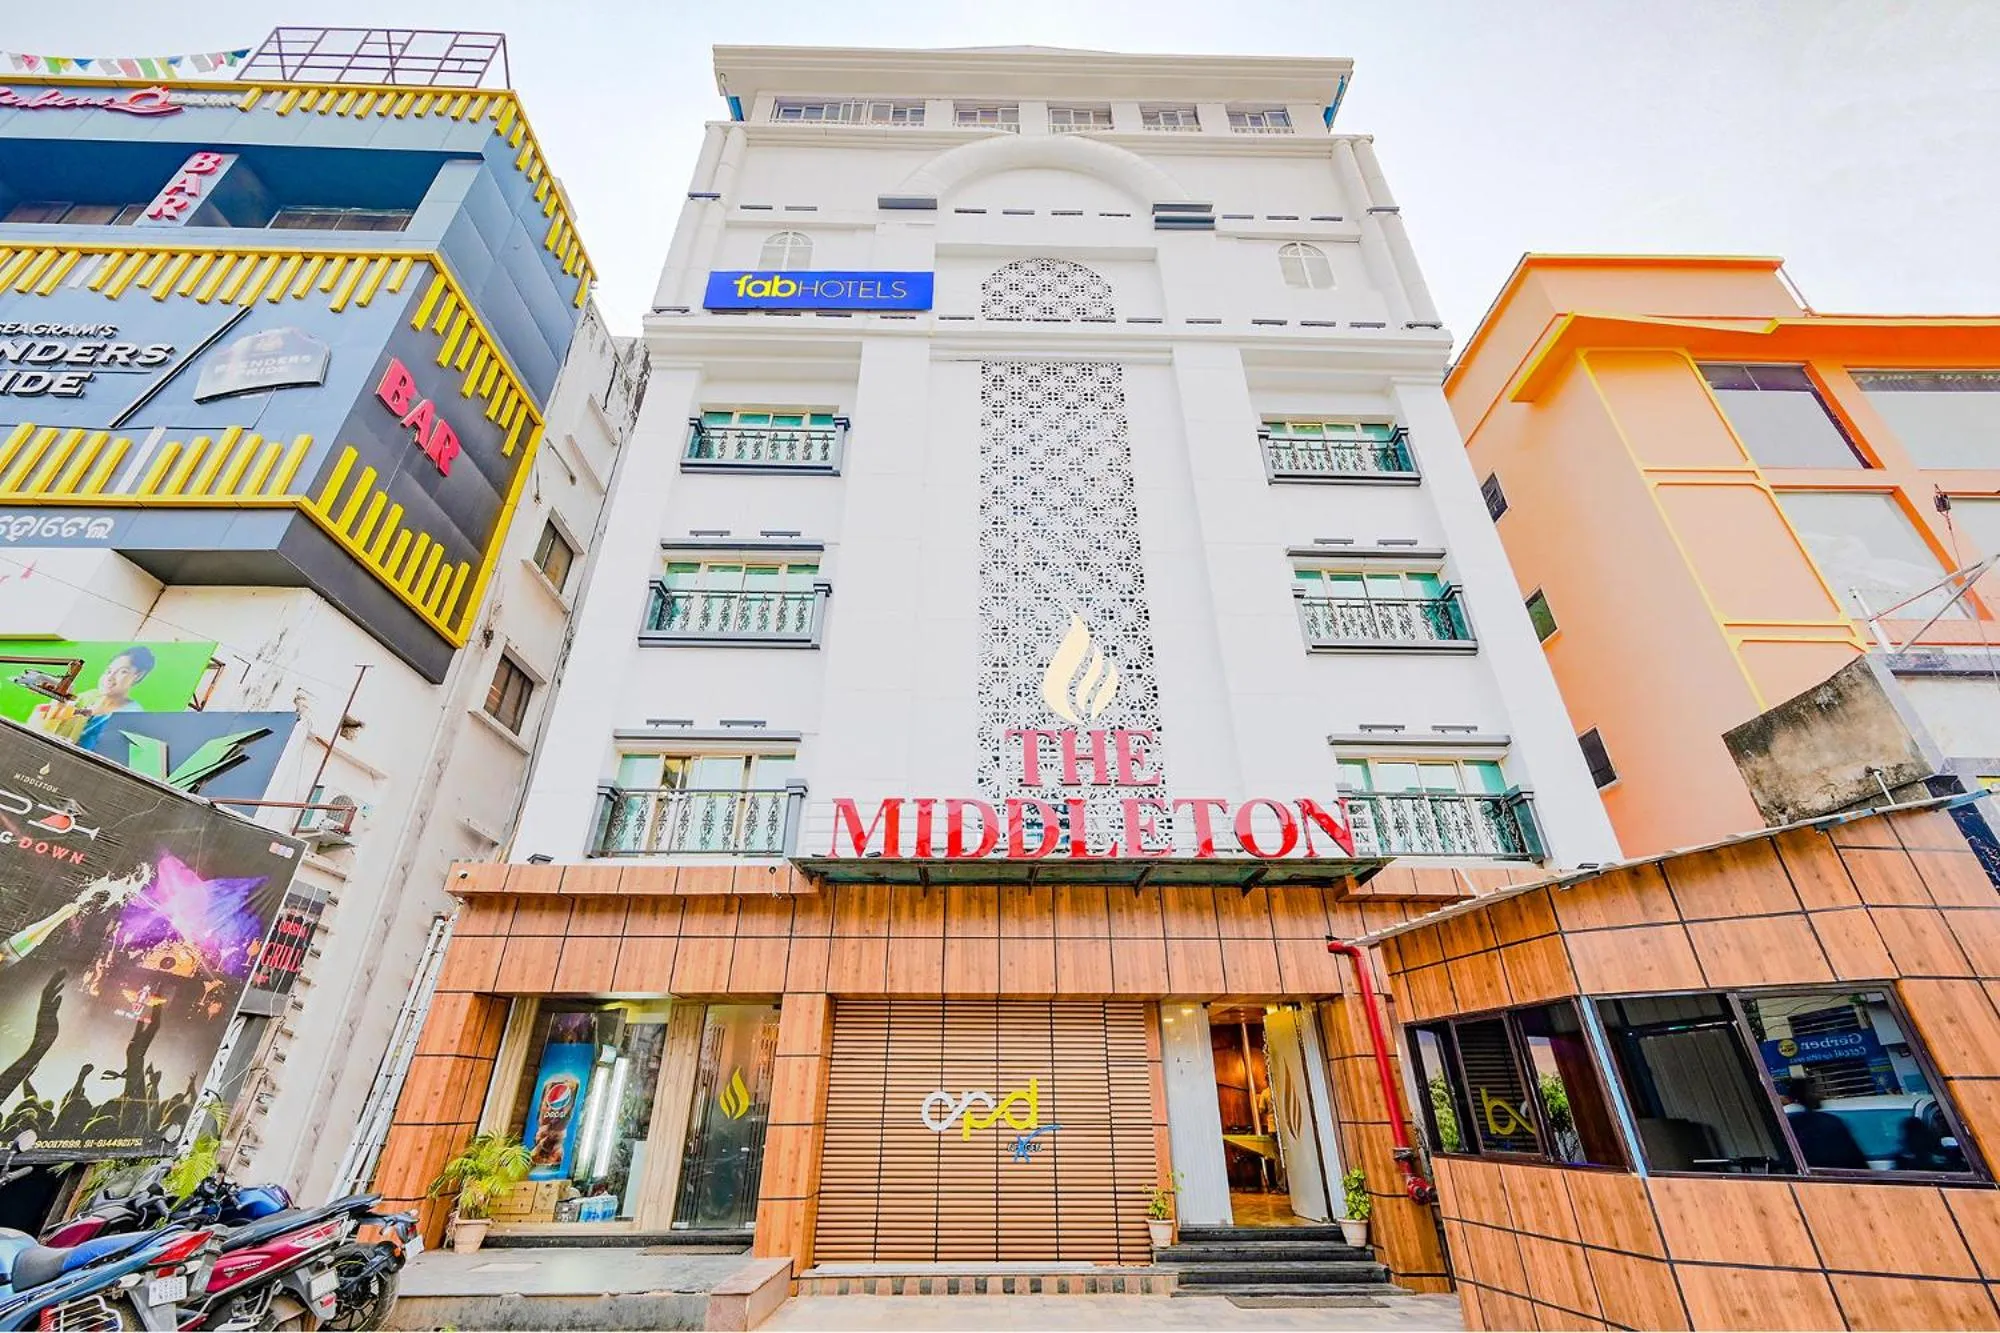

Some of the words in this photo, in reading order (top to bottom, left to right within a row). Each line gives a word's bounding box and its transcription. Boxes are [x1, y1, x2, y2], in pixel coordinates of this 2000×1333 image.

[147, 152, 224, 220] BAR
[374, 355, 461, 477] BAR
[1004, 729, 1162, 786] THE
[18, 836, 85, 864] DOWN
[831, 797, 1358, 859] MIDDLETON
